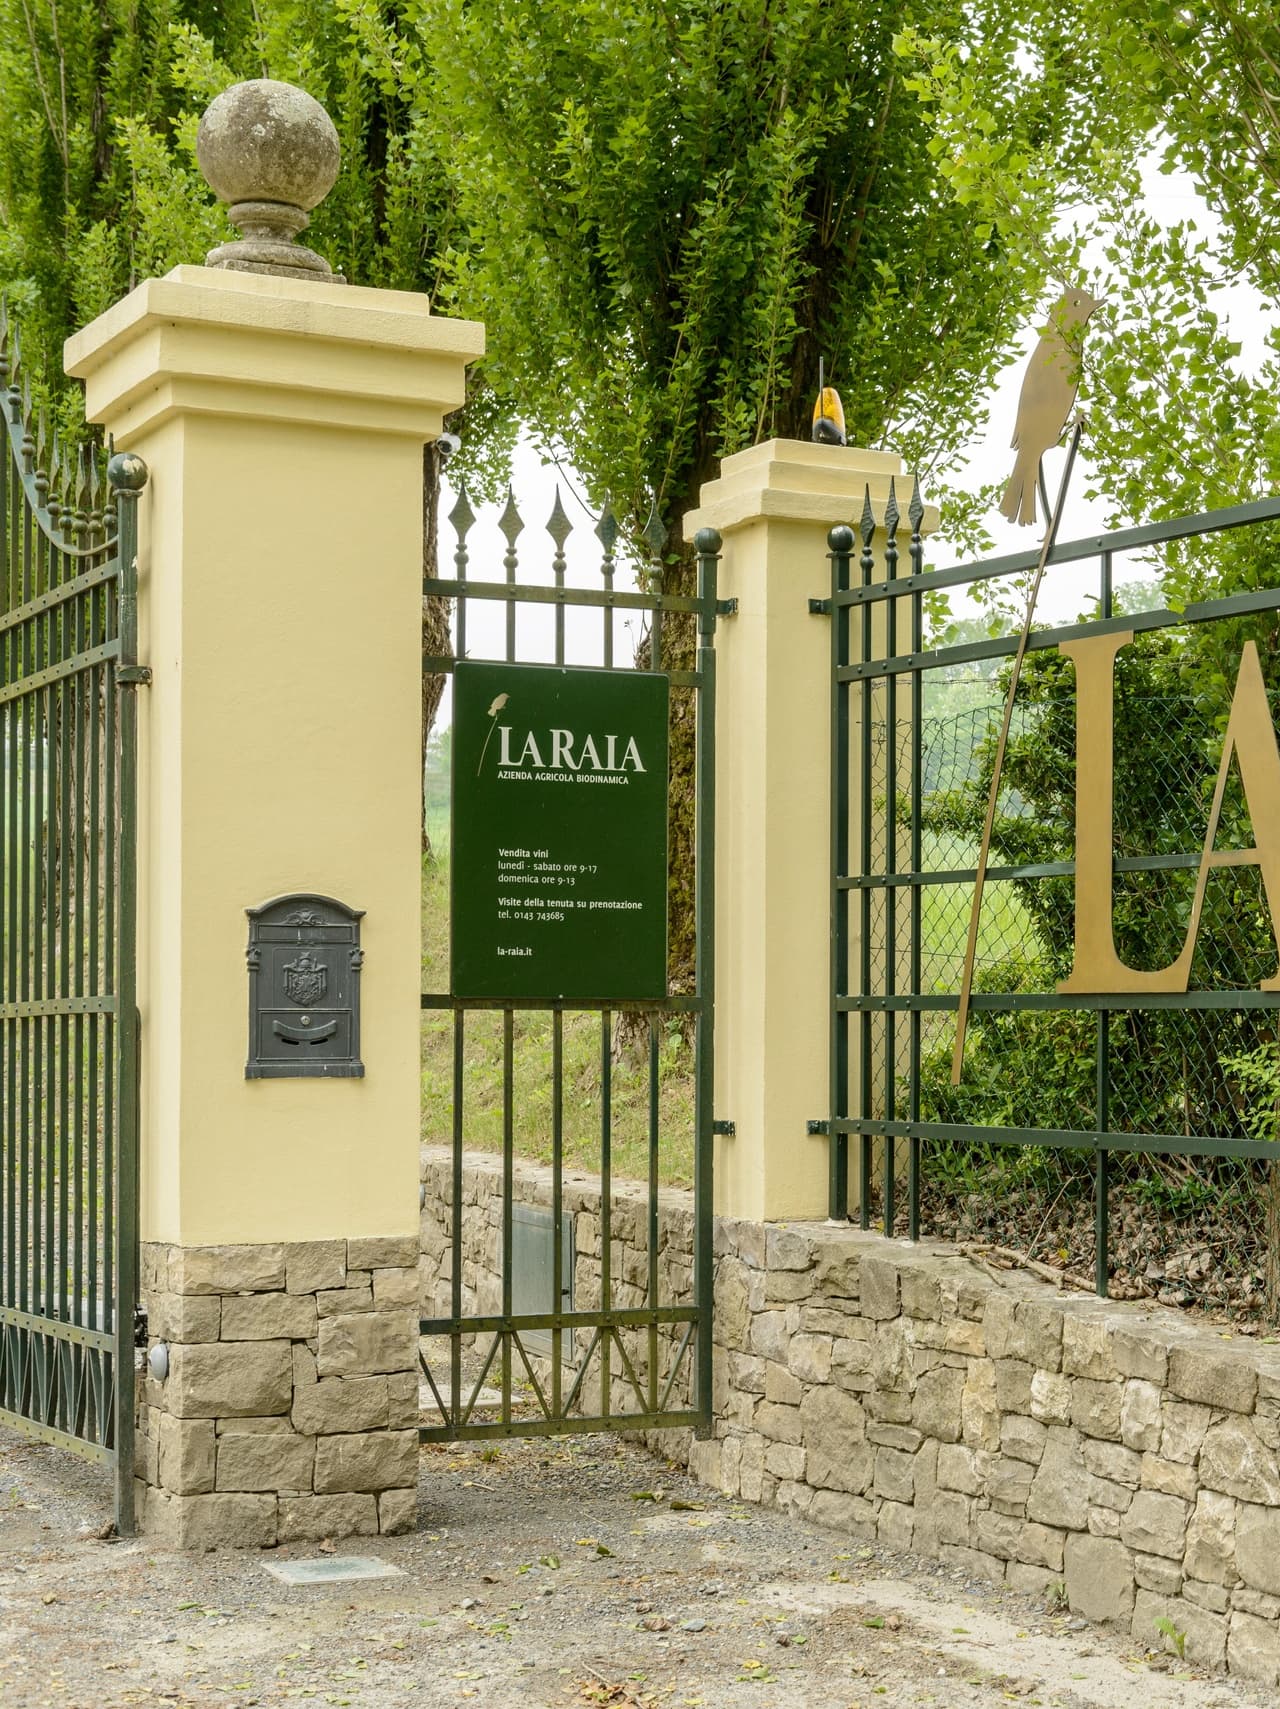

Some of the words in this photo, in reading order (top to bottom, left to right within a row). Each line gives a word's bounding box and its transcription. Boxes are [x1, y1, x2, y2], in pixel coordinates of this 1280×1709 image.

[497, 726, 546, 767] LA
[550, 729, 647, 773] RAIA
[498, 770, 532, 781] AZIENDA
[535, 773, 574, 782] AGRICOLA
[577, 775, 629, 784] BIODINAMICA
[499, 849, 530, 858] Vendita
[533, 850, 549, 858] vini
[533, 862, 561, 871] sabato
[580, 865, 597, 873] 9-17
[498, 874, 539, 883] domenica
[558, 877, 575, 886] 9-13
[498, 898, 521, 906] Visite
[524, 898, 544, 907] della
[547, 899, 574, 908] tenuta
[589, 901, 643, 910] prenotazione
[498, 910, 511, 919] tel.
[514, 912, 533, 920] 0143
[537, 911, 565, 921] 743685
[497, 947, 533, 956] la-raia.it
